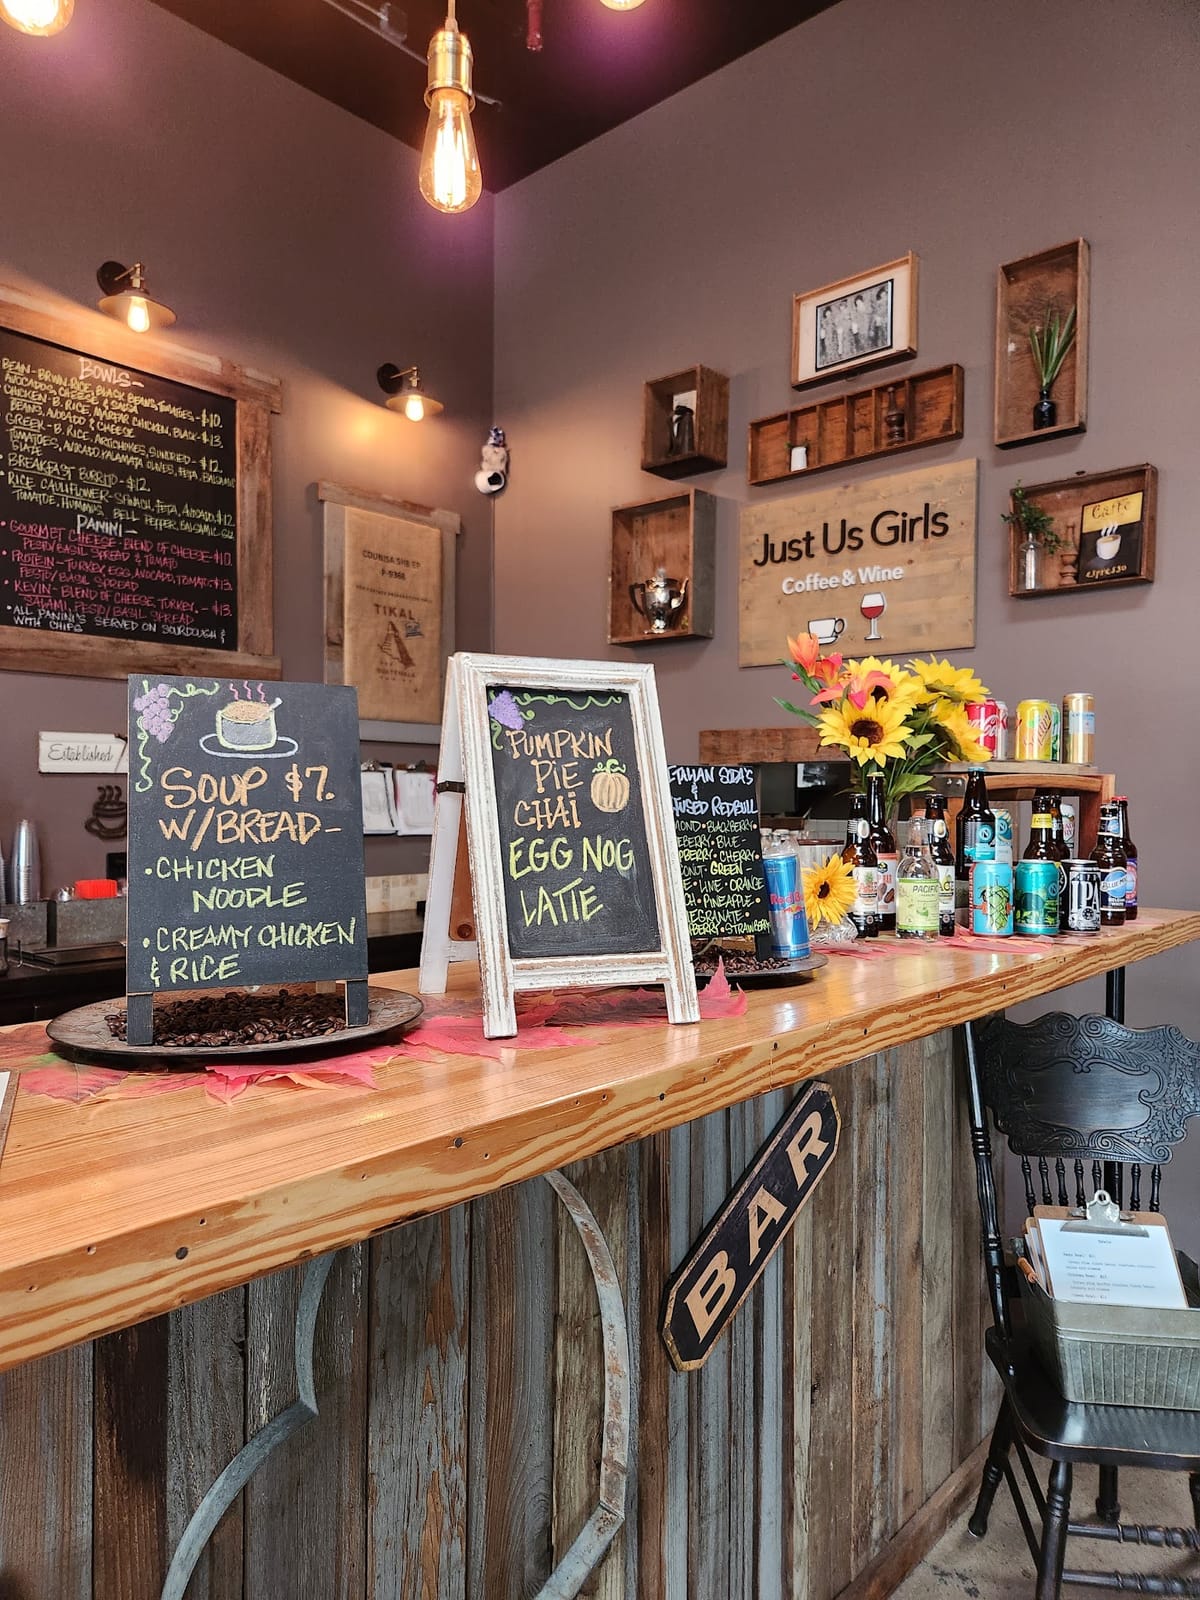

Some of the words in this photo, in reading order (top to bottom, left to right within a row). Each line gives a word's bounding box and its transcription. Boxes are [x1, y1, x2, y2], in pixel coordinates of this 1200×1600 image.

[4, 384, 47, 404] CHICKEN
[96, 384, 125, 401] BLACK
[6, 412, 46, 430] GREEK
[46, 408, 86, 425] AVOCADO
[97, 422, 136, 438] CHEESE
[8, 452, 76, 480] BREAKFAST
[79, 467, 118, 486] BURRITO
[8, 471, 34, 487] RICE
[40, 478, 109, 502] CAULIFLOWER
[113, 508, 140, 522] BELL
[10, 520, 65, 542] GOURMET
[68, 529, 116, 548] CHEESE
[124, 538, 154, 552] BLEND
[157, 542, 170, 554] OF
[753, 531, 815, 567] Just
[822, 518, 864, 555] Us
[870, 502, 950, 547] Girls
[12, 550, 54, 567] PROTEIN
[90, 548, 130, 562] SPREAD
[144, 554, 177, 571] TOMATO
[782, 572, 838, 595] Coffee
[841, 571, 855, 587] &
[858, 565, 904, 585] Wine
[1086, 564, 1128, 580] espresso
[14, 580, 51, 595] KEVIN
[62, 585, 98, 601] BLEND
[100, 590, 109, 601] OF
[96, 577, 139, 592] SPREAD
[13, 605, 33, 616] ALL
[96, 616, 138, 631] SERVED
[142, 622, 157, 632] ON
[162, 624, 217, 639] SOURDOUGH
[150, 611, 194, 625] SPREAD
[374, 603, 415, 620] TIKAL
[14, 616, 40, 628] WITH
[50, 622, 83, 633] CHIPS
[48, 743, 114, 761] Established
[505, 728, 613, 760] PUMPKIN
[160, 766, 268, 809] SOUP
[712, 796, 759, 818] REDBULL
[706, 819, 754, 834] BLACKBERRY
[509, 836, 574, 881] EGG
[582, 835, 634, 873] NOG
[720, 849, 756, 863] CHERRY
[156, 854, 275, 881] CHICKEN
[699, 880, 724, 893] LIME
[730, 875, 765, 892] ORANGE
[192, 882, 308, 913] NOODLE
[520, 876, 604, 928] LATTE
[703, 894, 755, 908] PINEAPPLE
[770, 892, 794, 905] Red
[1072, 880, 1100, 912] IPA
[157, 925, 253, 953] CREAMY
[258, 916, 356, 948] CHICKEN
[725, 919, 770, 935] STRAWBERRY
[170, 953, 241, 984] RICE
[683, 1110, 829, 1344] BAR
